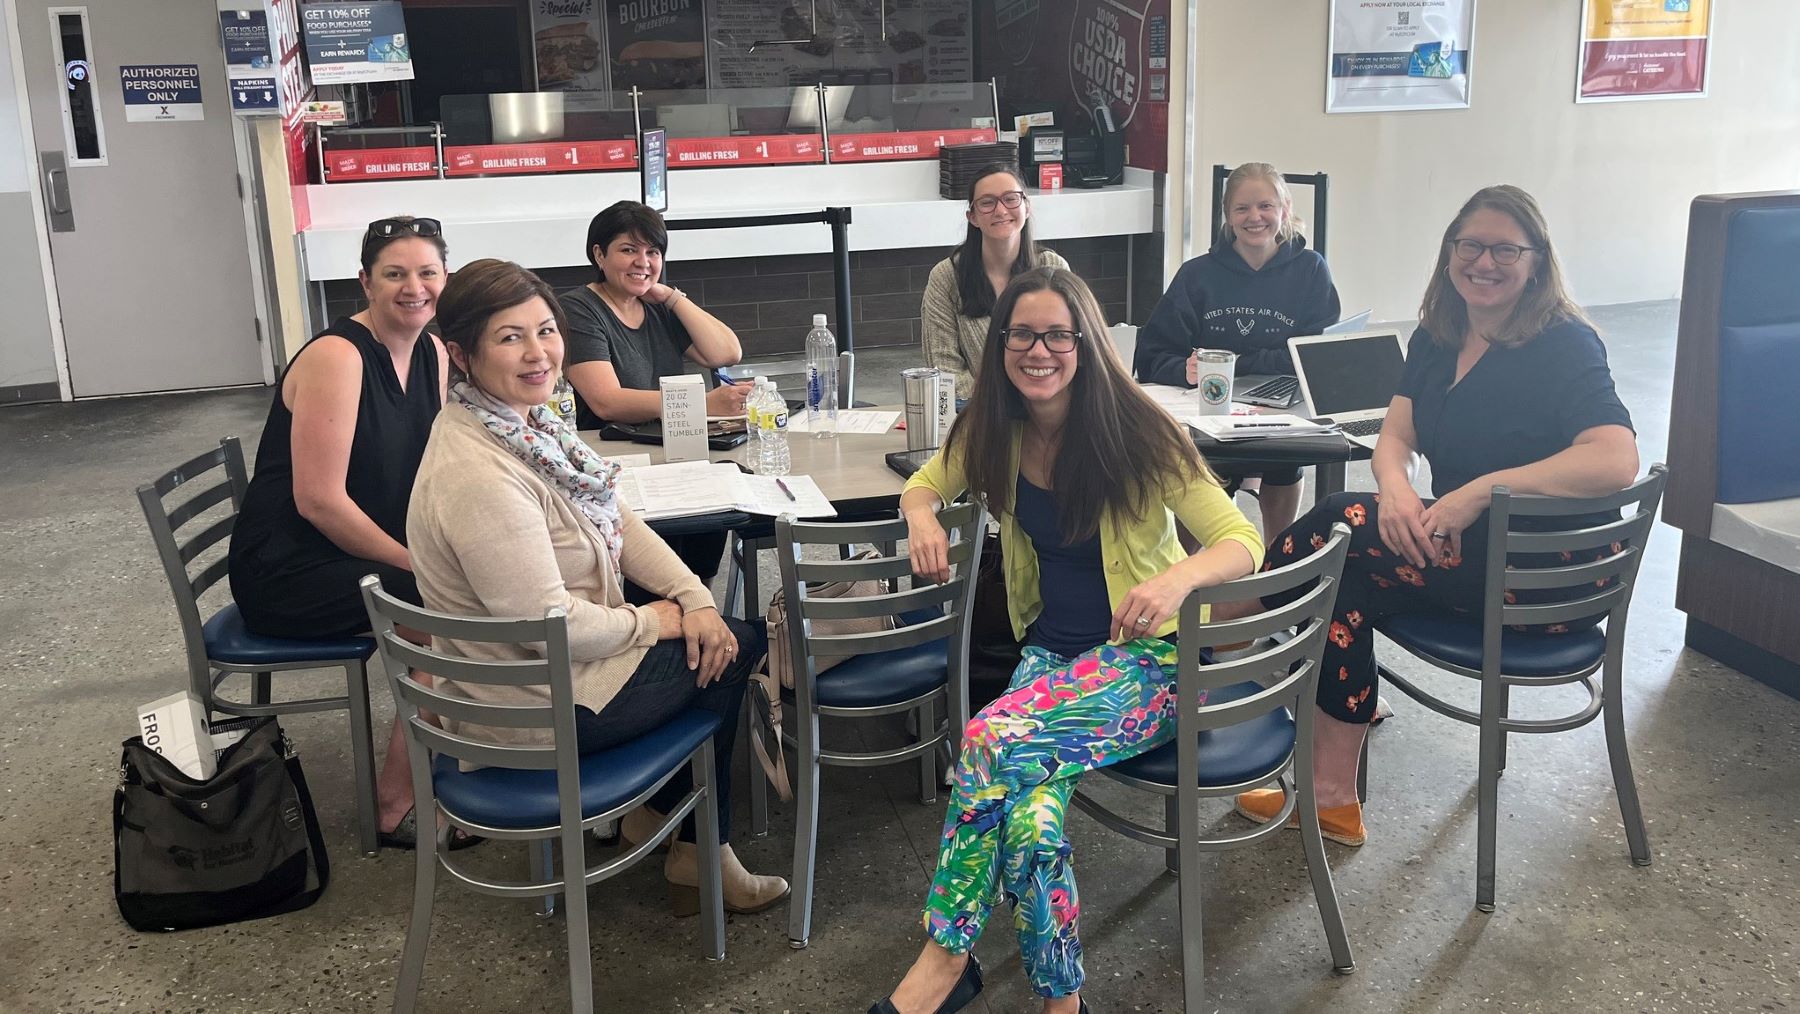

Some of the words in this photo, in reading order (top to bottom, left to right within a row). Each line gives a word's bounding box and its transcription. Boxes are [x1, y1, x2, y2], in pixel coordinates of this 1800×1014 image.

[547, 0, 584, 15] Special
[304, 9, 325, 20] GET
[327, 9, 349, 19] 10%
[351, 8, 371, 18] OFF
[1096, 7, 1119, 31] 100%
[306, 22, 328, 30] FOOD
[1085, 17, 1126, 68] USDA
[320, 50, 337, 58] EARN
[337, 49, 366, 57] REWARDS
[122, 67, 198, 78] AUTHORIZED
[1073, 42, 1135, 105] CHOICE
[125, 80, 198, 90] PERSONNEL
[147, 91, 179, 101] ONLY
[756, 141, 769, 158] #1
[863, 147, 893, 156] GRILLING
[894, 145, 918, 154] FRESH
[564, 147, 579, 165] #1
[679, 151, 713, 161] GRILLING
[713, 150, 739, 160] FRESH
[365, 163, 401, 174] GRILLING
[402, 162, 430, 172] FRESH
[482, 158, 518, 169] GRILLING
[519, 157, 546, 166] FRESH
[1204, 309, 1223, 320] ITED
[1225, 306, 1255, 315] STATES
[1258, 308, 1271, 316] AIR
[1273, 310, 1295, 327] FORCE
[666, 393, 675, 401] 20
[677, 392, 687, 400] OZ
[666, 411, 686, 419] LESS
[667, 420, 691, 429] STEEL
[668, 428, 704, 438] TUMBLER
